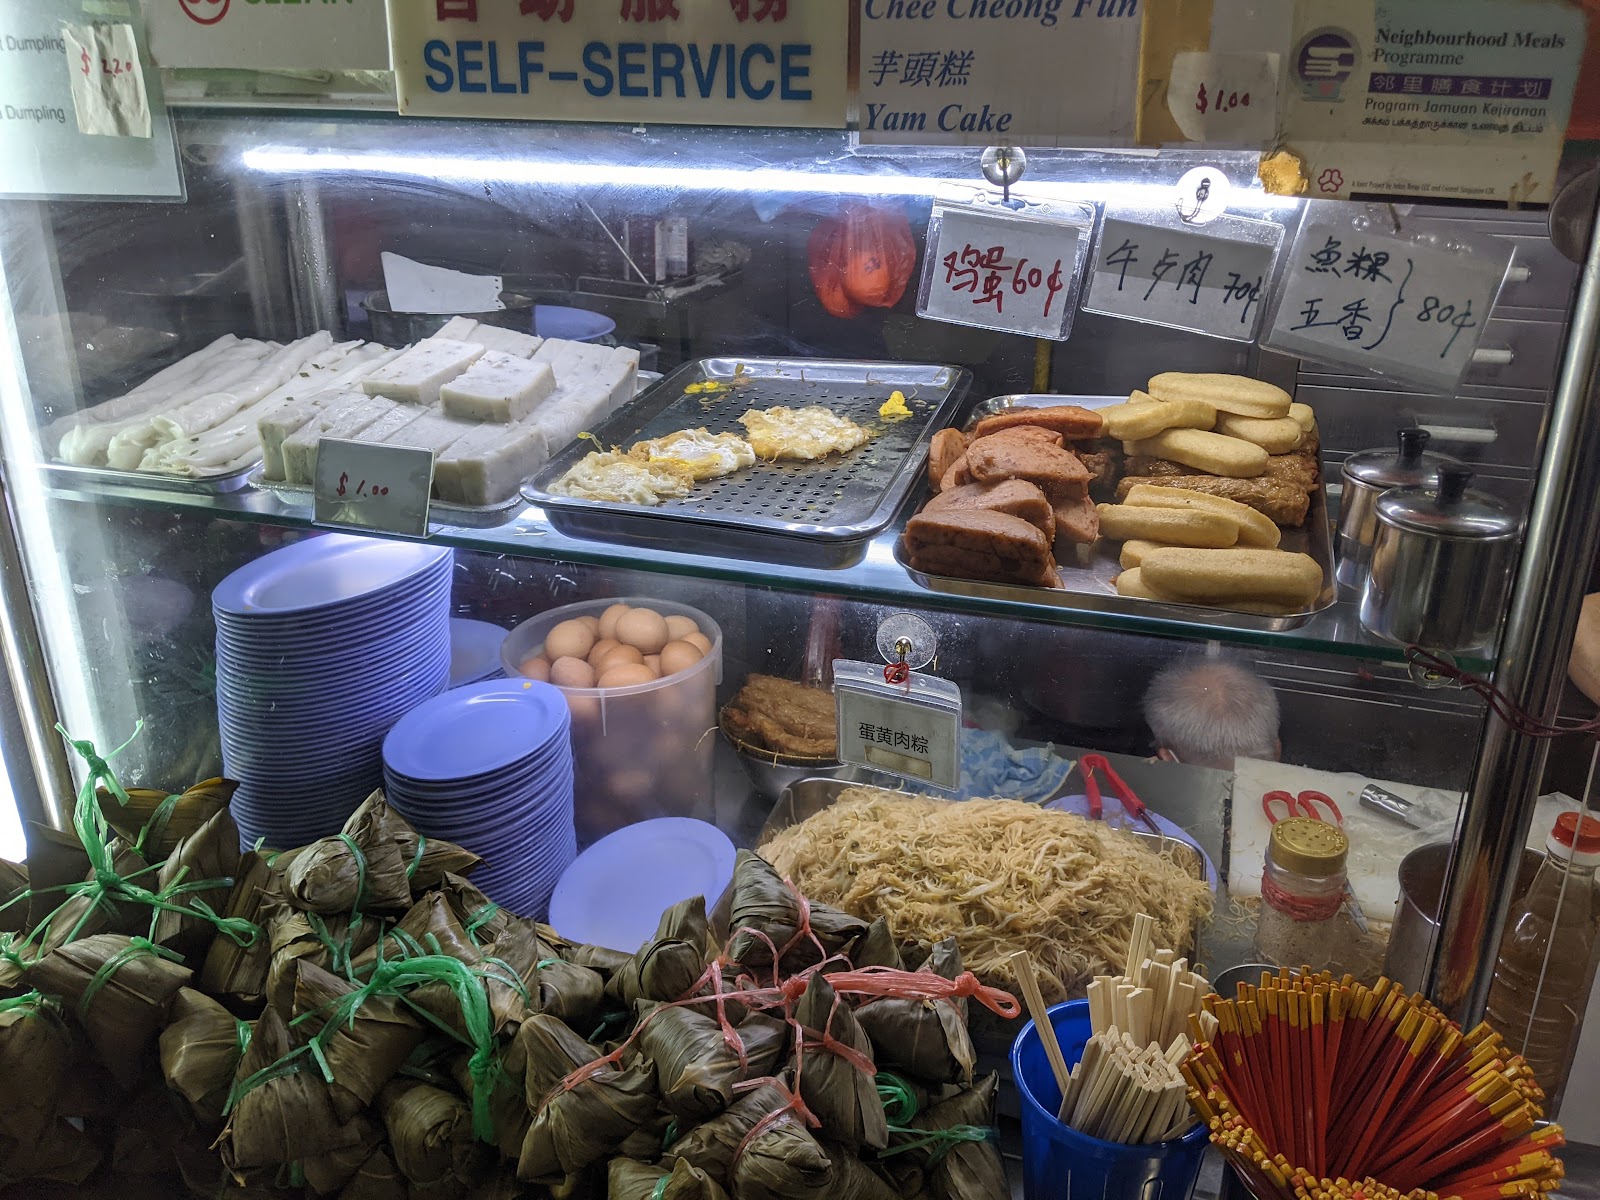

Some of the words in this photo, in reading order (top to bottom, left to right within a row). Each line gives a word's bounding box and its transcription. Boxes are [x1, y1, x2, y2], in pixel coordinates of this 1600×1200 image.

[866, 0, 936, 20] Chee
[947, 0, 1058, 27] Cheong
[1071, 0, 1138, 19] Fun
[6, 35, 66, 55] Dumpling
[1376, 28, 1508, 48] Neighbourhood
[1512, 31, 1566, 49] Meals
[423, 40, 813, 100] SELF-SERVICE
[868, 50, 976, 88] 芋頭糕
[1373, 48, 1465, 67] Programme
[1373, 74, 1544, 98] 邻里膳食计划
[5, 104, 66, 123] Dumpling
[865, 103, 927, 132] Yam
[937, 103, 1013, 132] Cake
[1364, 98, 1420, 114] Program
[1423, 102, 1478, 115] Jamuan
[1482, 102, 1547, 118] Kejiranan
[943, 244, 1012, 314] 鸡蛋
[1290, 298, 1372, 341] 五香
[858, 721, 929, 755] 蛋黄肉粽
